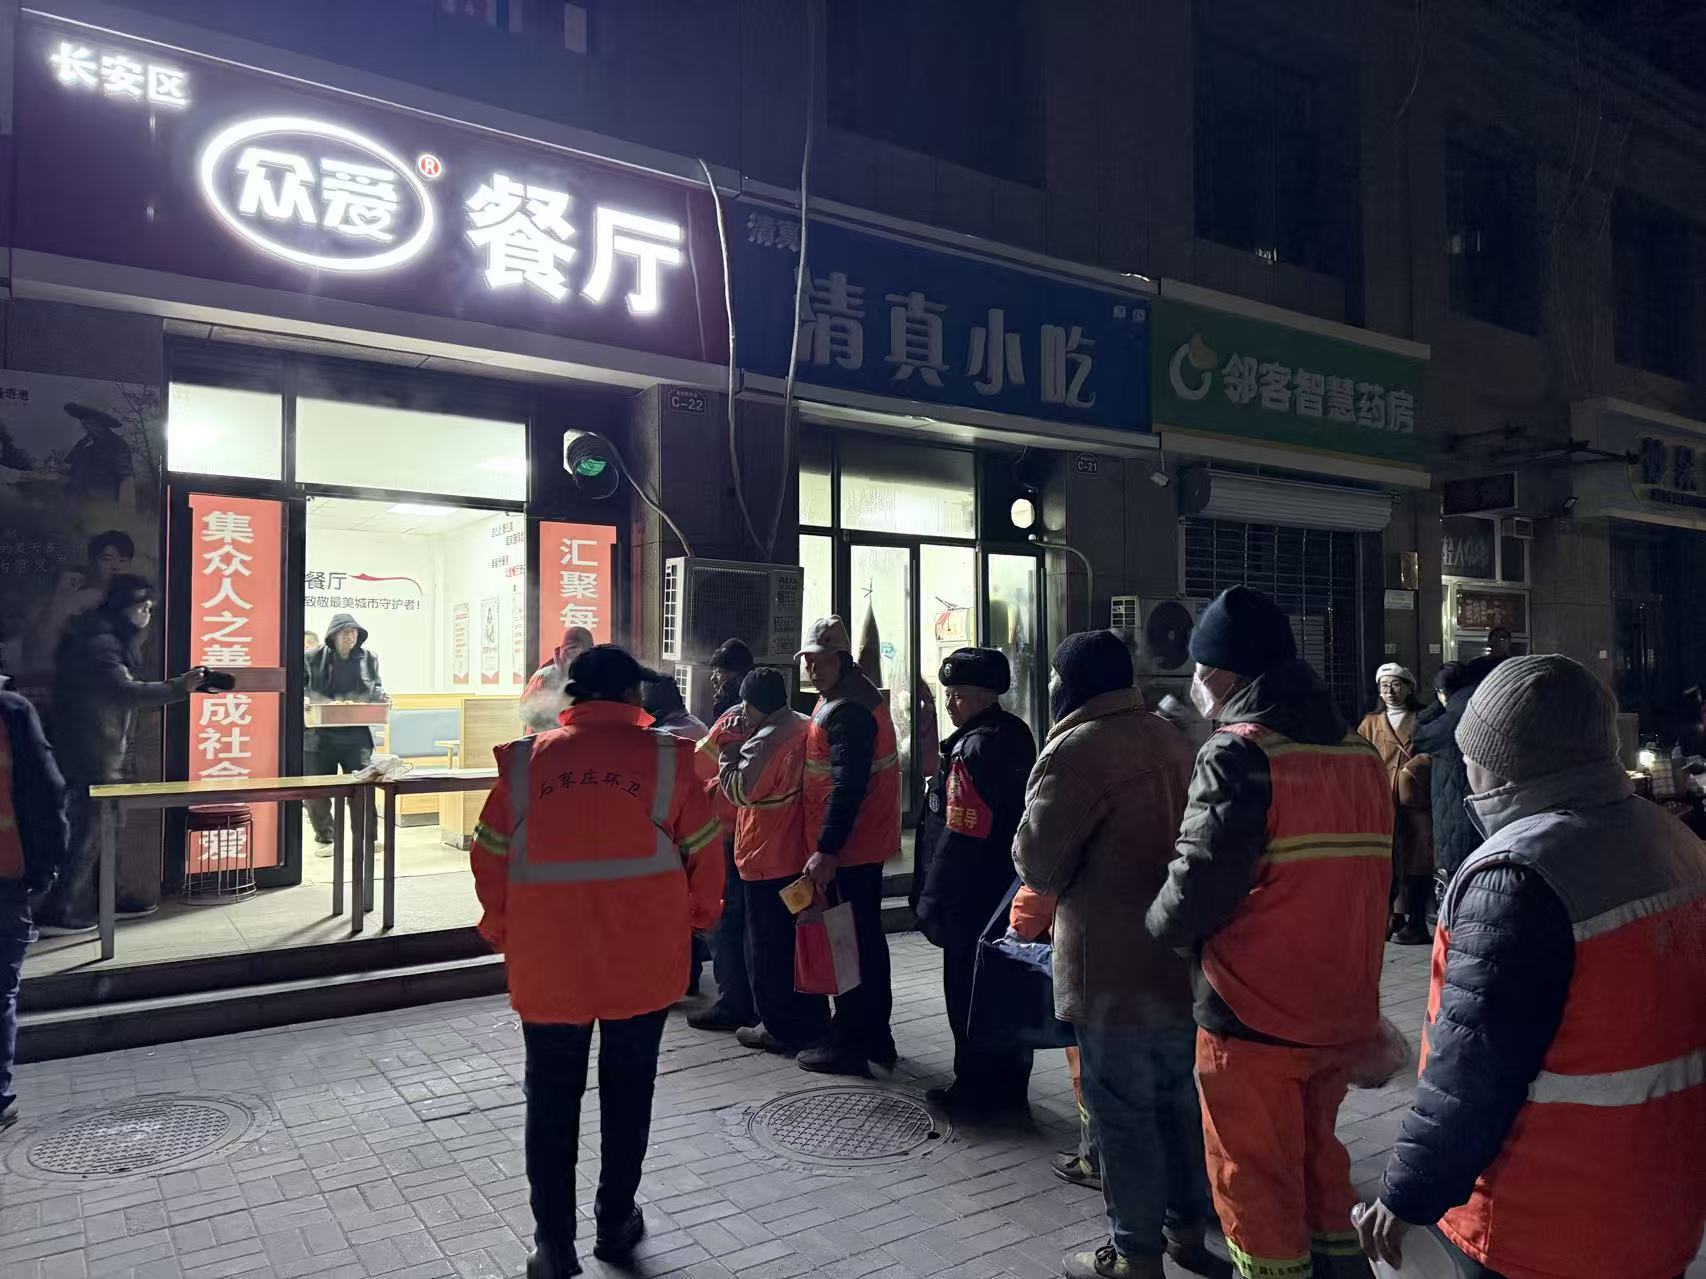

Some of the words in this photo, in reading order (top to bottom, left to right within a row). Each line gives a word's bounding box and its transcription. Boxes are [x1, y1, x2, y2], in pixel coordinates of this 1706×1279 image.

[52, 43, 190, 107] 长安区
[236, 147, 398, 243] 众爱
[465, 173, 684, 316] 餐厅
[793, 264, 1096, 409] 清真小吃
[671, 396, 703, 411] C-22
[1221, 352, 1415, 434] 邻客智慧药房
[304, 571, 348, 590] 餐厅
